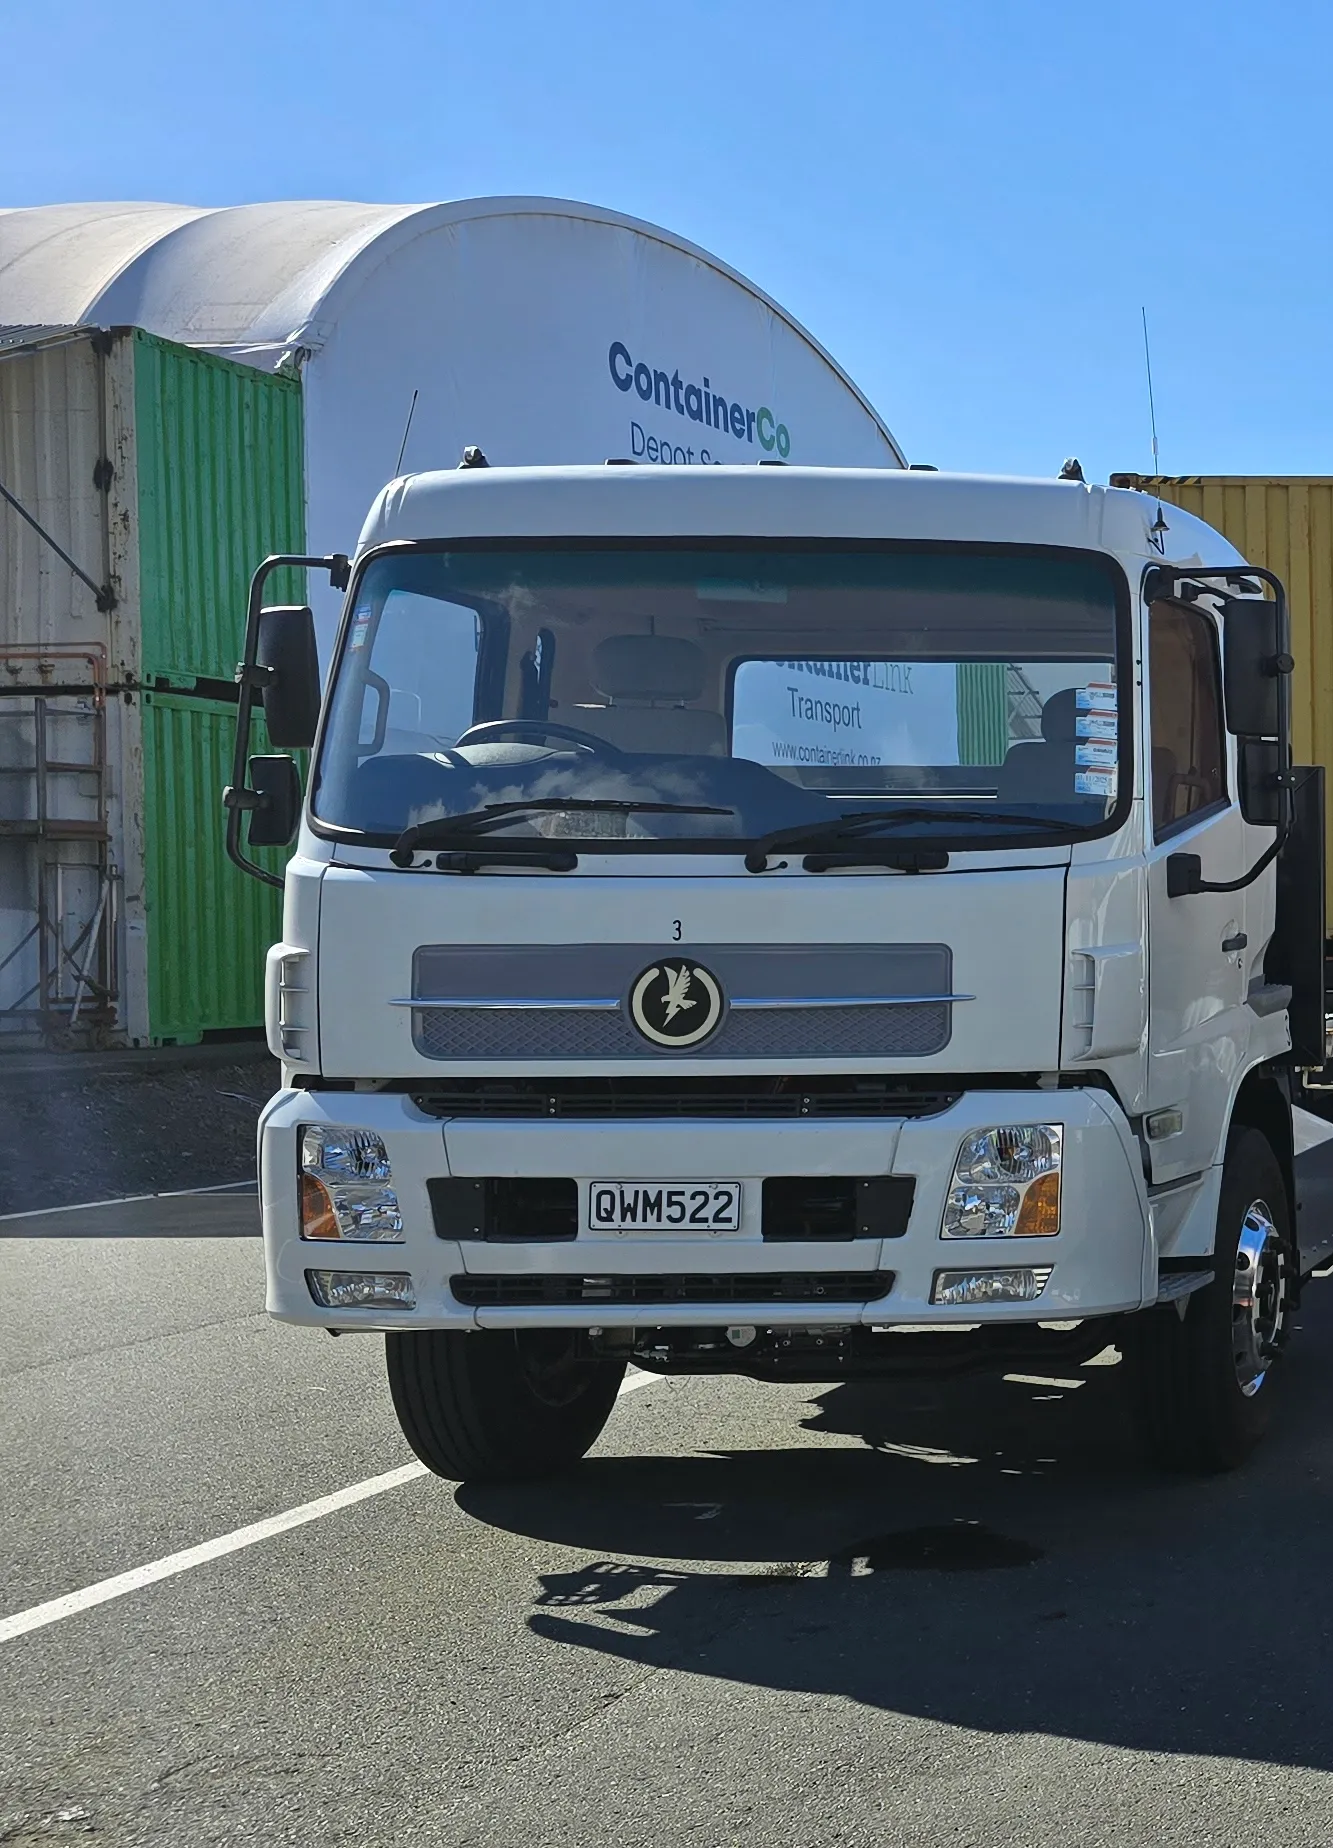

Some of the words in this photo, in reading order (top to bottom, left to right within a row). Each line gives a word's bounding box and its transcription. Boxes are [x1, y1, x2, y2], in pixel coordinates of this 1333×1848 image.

[608, 341, 791, 458] ContainerCo
[631, 421, 694, 465] Depot
[762, 661, 914, 695] ainerLink
[787, 686, 862, 732] Transport
[772, 741, 881, 765] www.containerlinkconz
[672, 919, 682, 941] 3
[595, 1189, 733, 1224] QWM522
